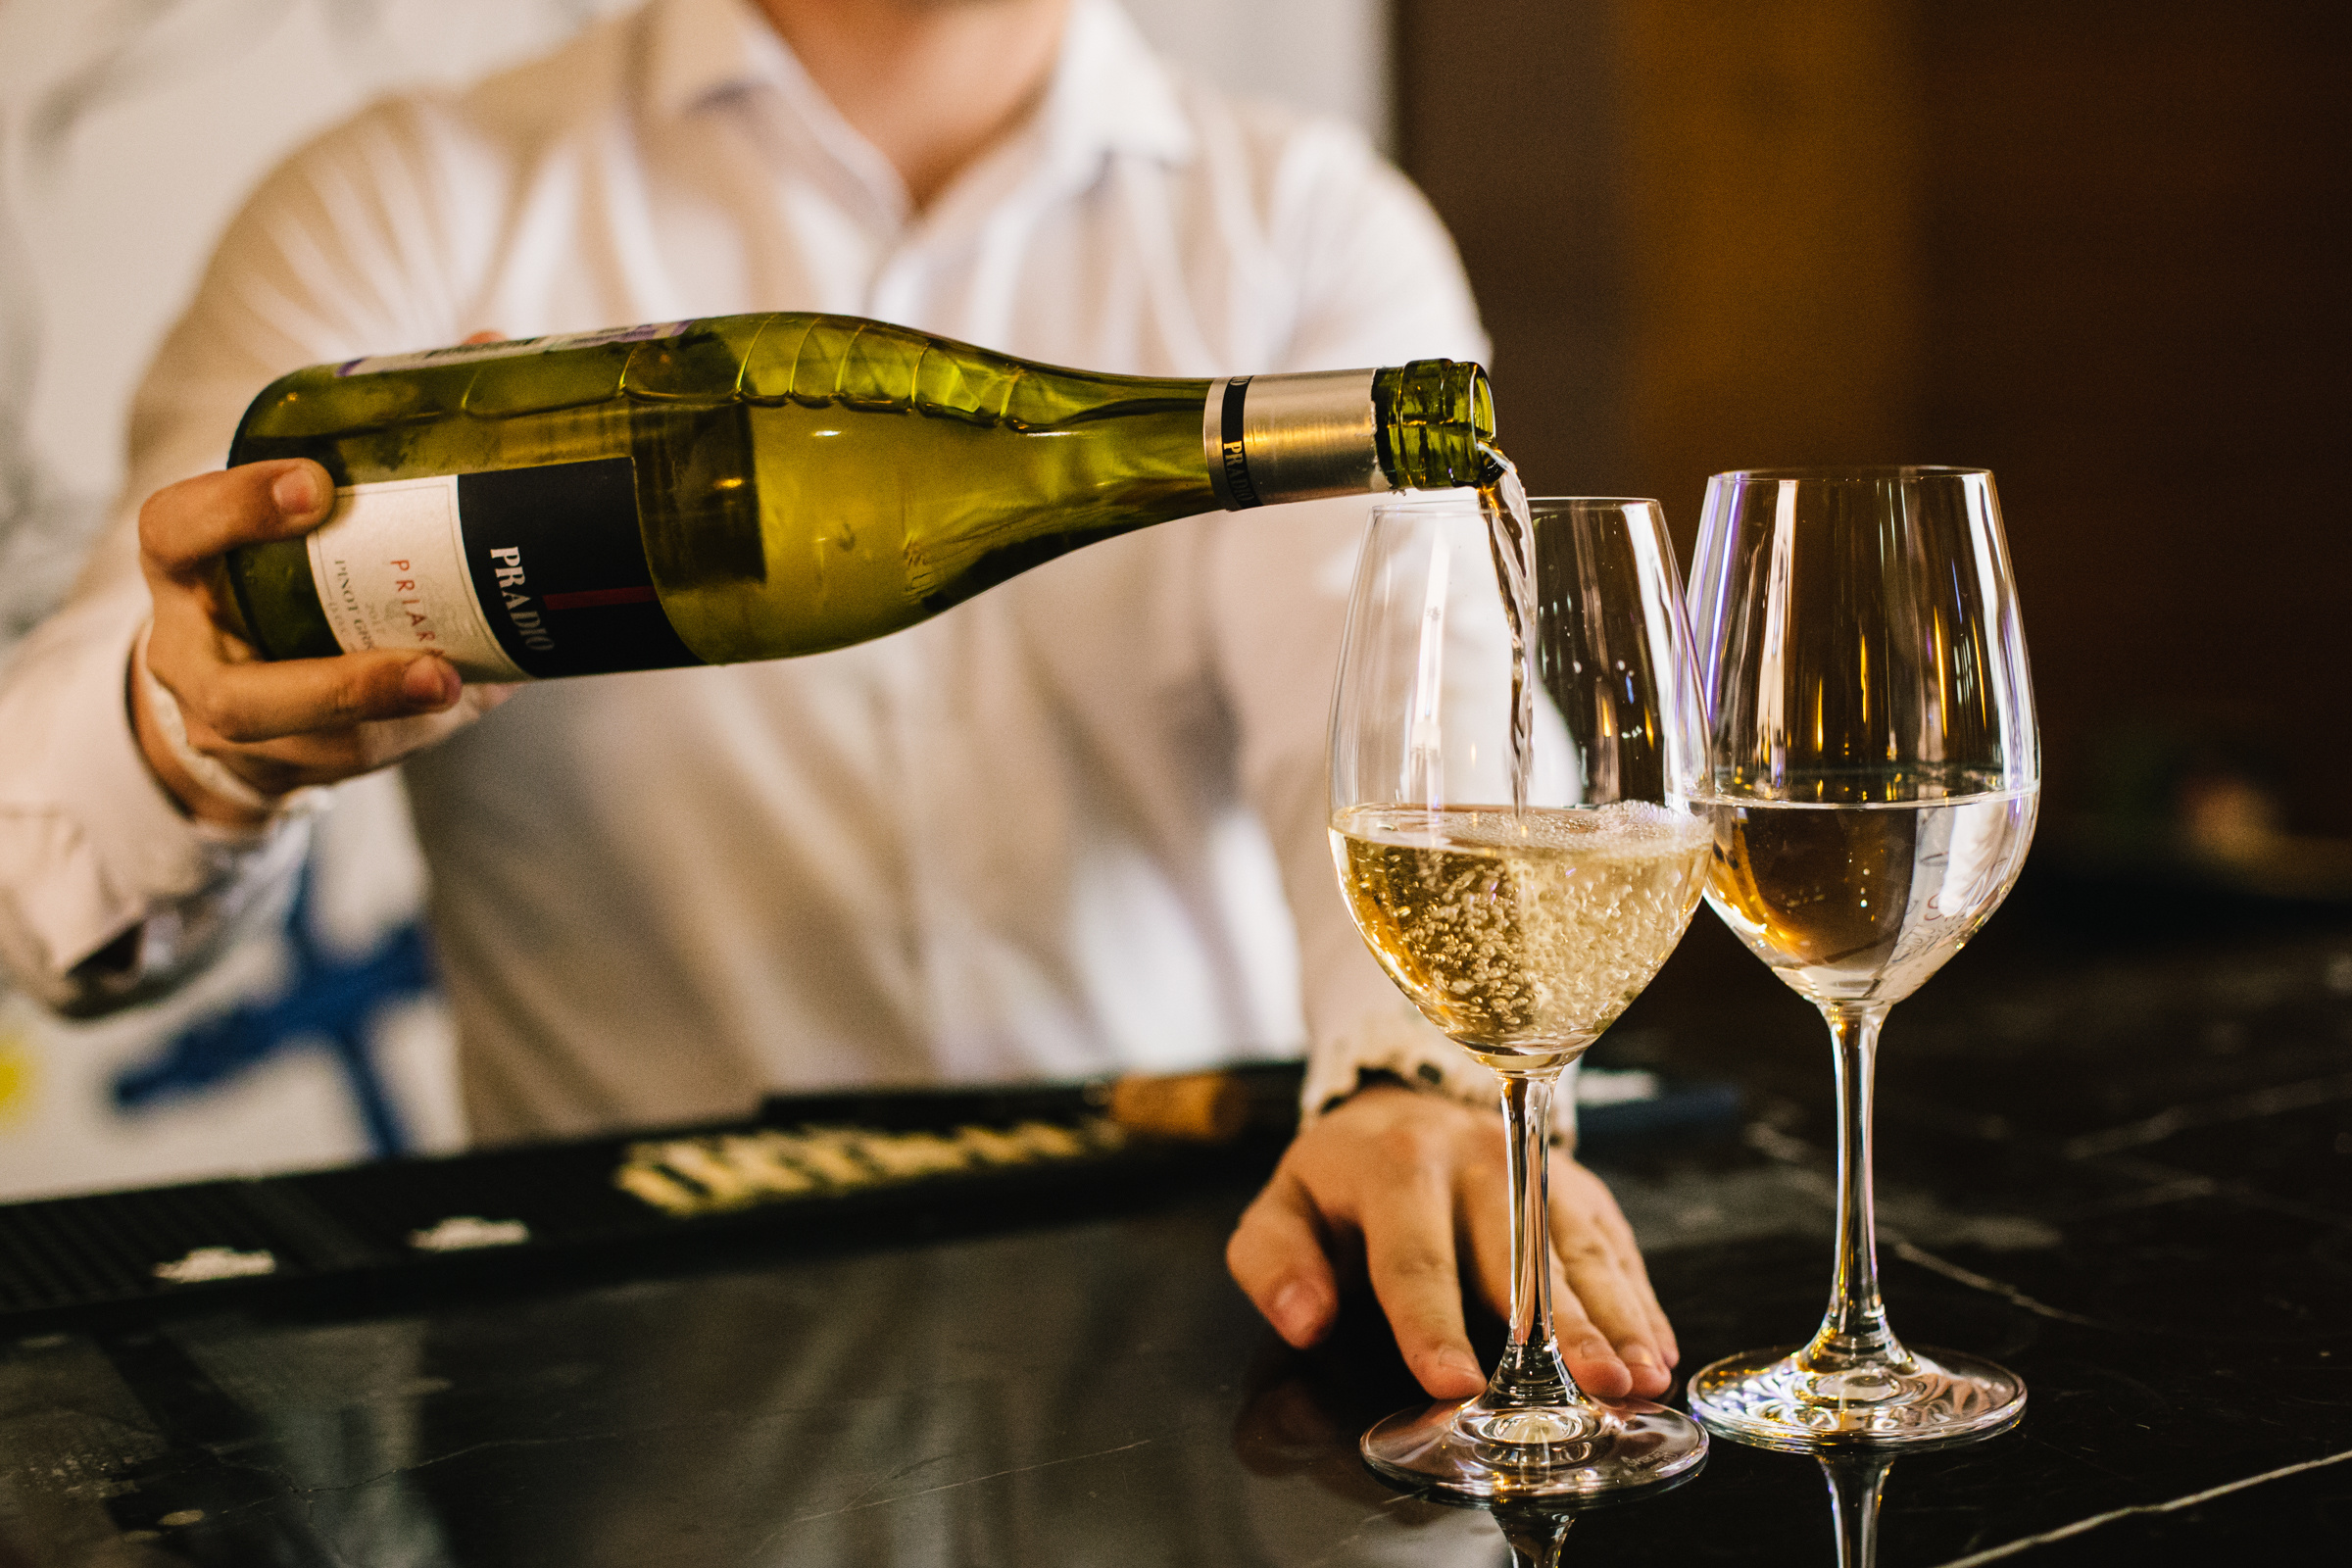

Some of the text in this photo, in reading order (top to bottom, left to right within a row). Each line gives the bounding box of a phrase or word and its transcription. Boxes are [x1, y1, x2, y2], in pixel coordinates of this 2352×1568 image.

[1223, 441, 1254, 502] PRADIO
[335, 560, 359, 613] PINOT
[490, 546, 555, 651] PRADIO
